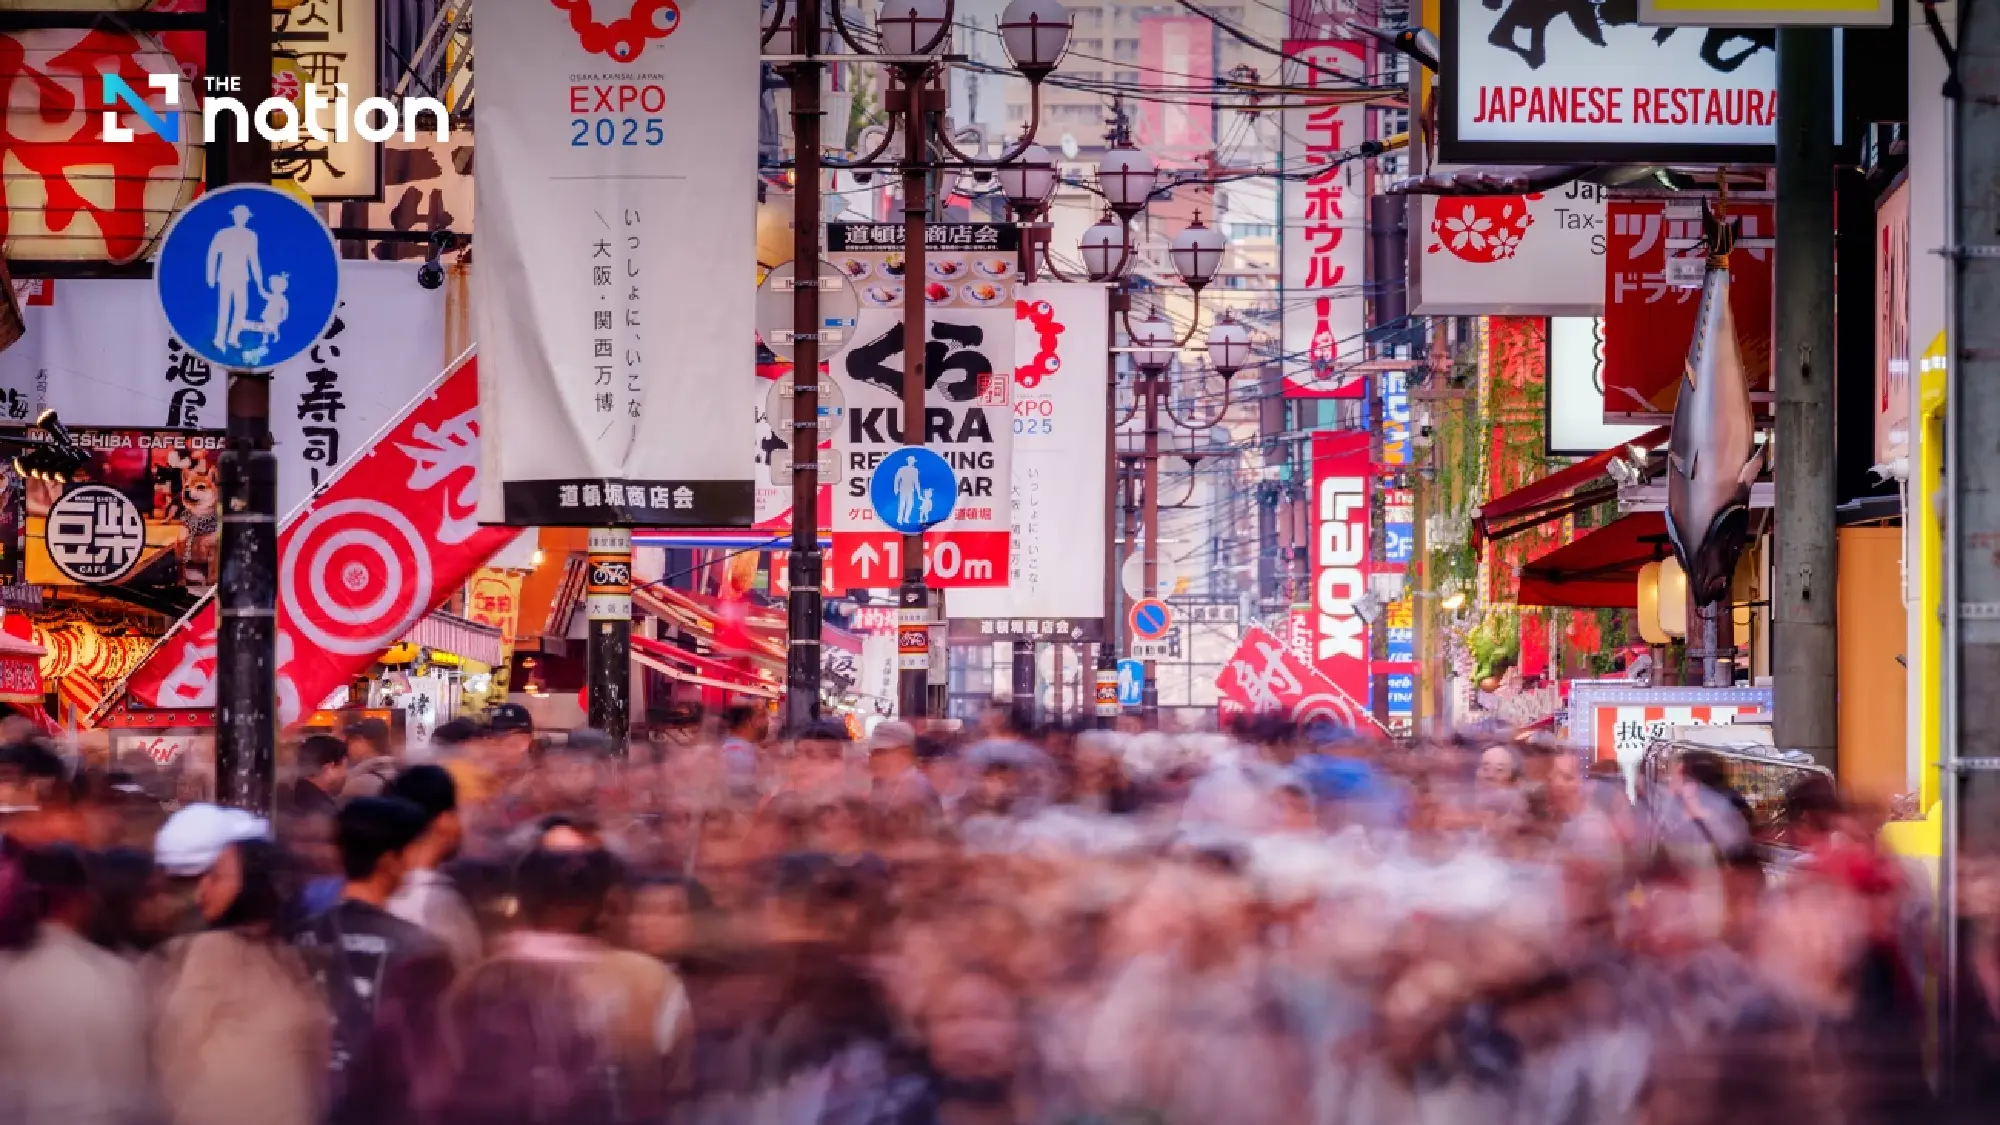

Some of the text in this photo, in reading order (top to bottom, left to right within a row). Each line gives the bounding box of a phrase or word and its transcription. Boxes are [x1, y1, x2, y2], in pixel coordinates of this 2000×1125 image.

[570, 85, 666, 113] EXPO
[1474, 86, 1623, 124] JAPANESE
[571, 118, 664, 147] 2025
[1014, 418, 1053, 434] 025
[138, 436, 186, 449] CAFE
[559, 484, 694, 509] 道頓堀商店会
[79, 565, 107, 575] CAFE
